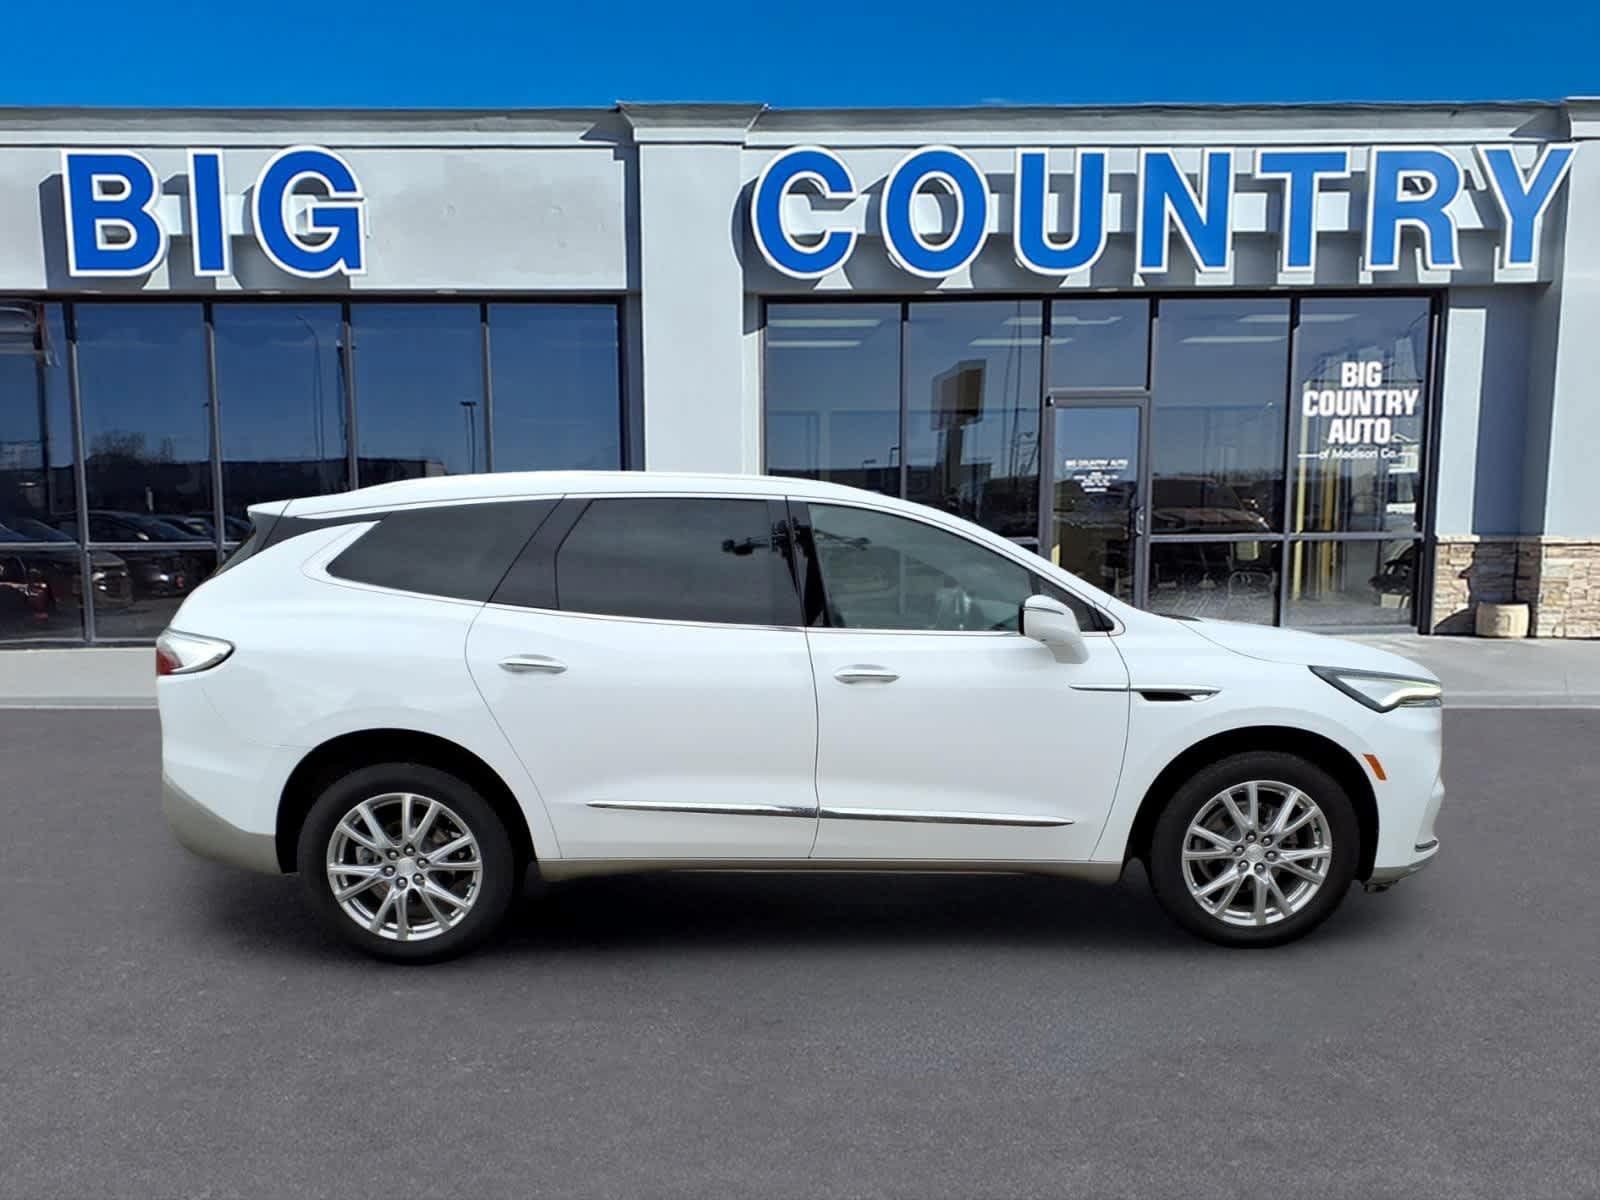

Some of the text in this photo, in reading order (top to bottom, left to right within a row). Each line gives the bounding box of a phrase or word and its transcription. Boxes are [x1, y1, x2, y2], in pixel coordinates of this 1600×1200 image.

[61, 145, 1576, 279] BIG COUNTRY
[1341, 361, 1382, 388] BIG
[1302, 389, 1419, 416] COUNTRY
[1327, 418, 1391, 444] AUTO
